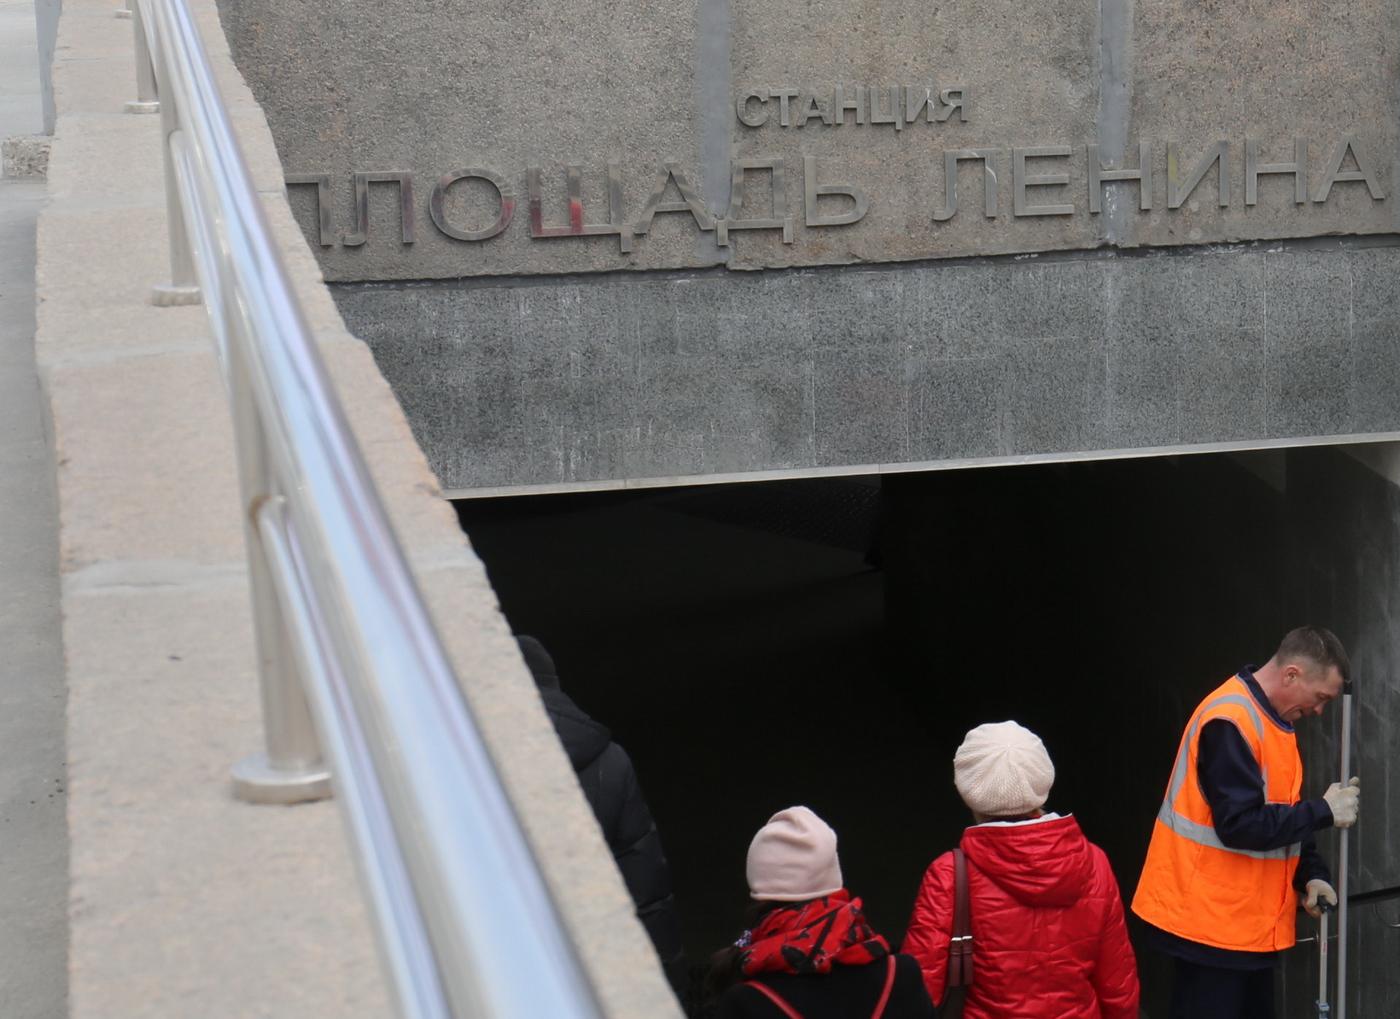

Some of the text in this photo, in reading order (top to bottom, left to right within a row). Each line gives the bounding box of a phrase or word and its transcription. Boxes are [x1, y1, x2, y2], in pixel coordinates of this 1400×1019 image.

[736, 85, 968, 130] СТАНЦИЯ
[284, 135, 1386, 253] ПЛОЩАДЬ ЛЕНИНА
